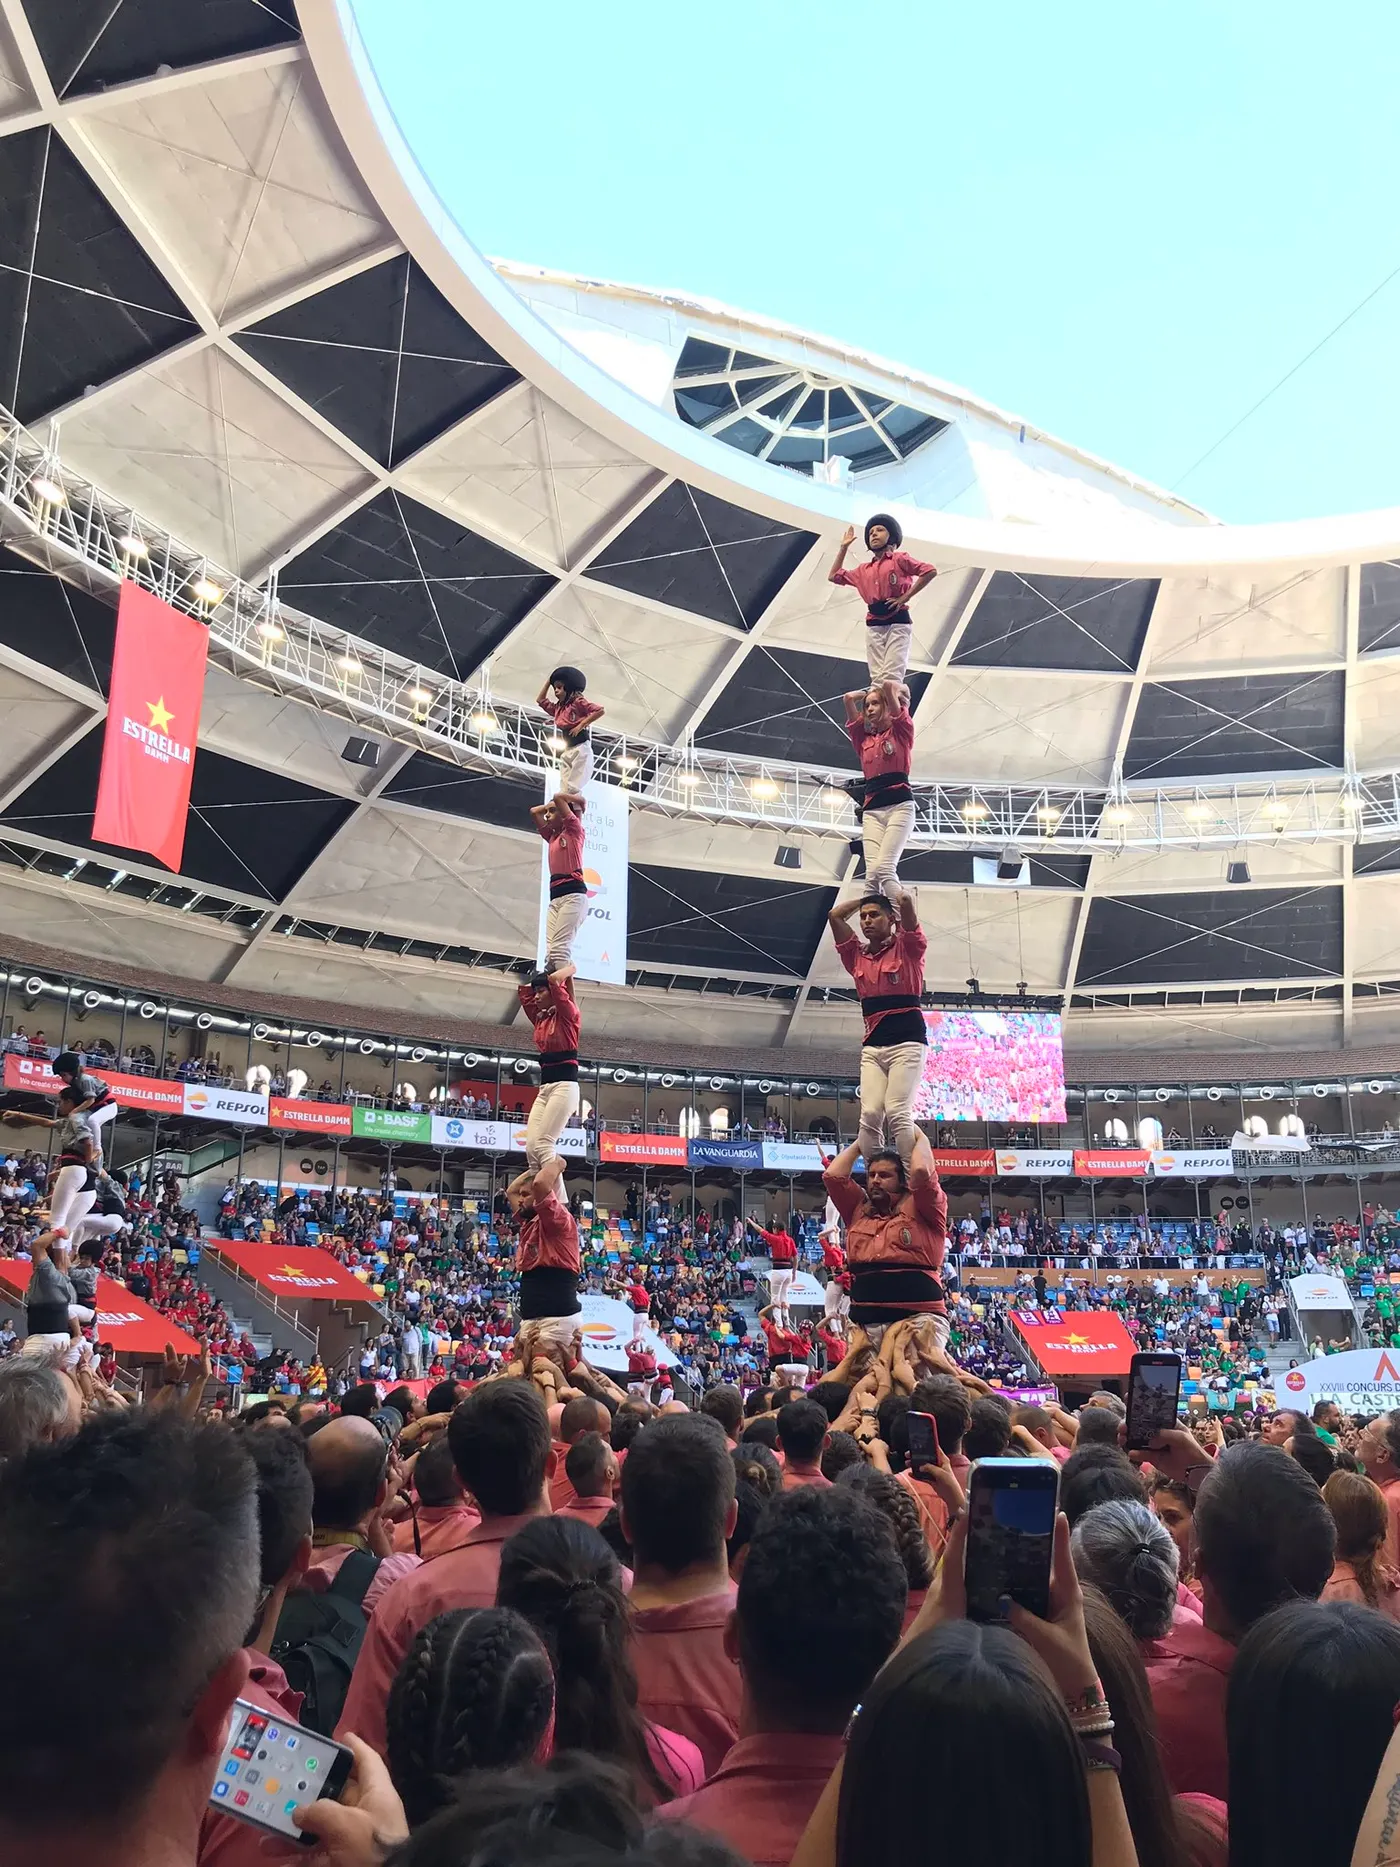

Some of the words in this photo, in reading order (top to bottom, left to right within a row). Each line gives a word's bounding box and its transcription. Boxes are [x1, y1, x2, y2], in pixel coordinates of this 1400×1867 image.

[123, 716, 190, 765] ESTRELLA
[144, 744, 169, 764] DAMM
[605, 815, 615, 828] la
[111, 1085, 153, 1100] ESTRELLA
[154, 1091, 182, 1104] DAMM
[216, 1100, 267, 1116] REPSOL
[283, 1110, 324, 1123] ESTRELLA
[324, 1114, 350, 1126] DAMM
[384, 1113, 420, 1127] BASF
[474, 1132, 497, 1146] tac
[556, 1137, 585, 1148] PSOL
[615, 1144, 657, 1156] ESTRELLA
[658, 1146, 685, 1157] DAMM
[693, 1146, 704, 1156] LA
[704, 1147, 759, 1159] VANGUARDIA
[165, 1161, 182, 1171] BAR
[935, 1159, 968, 1167] STRELLA
[1026, 1159, 1074, 1168] REPSOL
[1087, 1160, 1126, 1168] ESTRELLA
[1184, 1158, 1231, 1168] REPSOL
[267, 1273, 339, 1285] ESTRELLA
[1044, 1342, 1119, 1350] ESTRELLA
[1320, 1382, 1345, 1392] XXVIII
[1346, 1382, 1393, 1392] CONCURS
